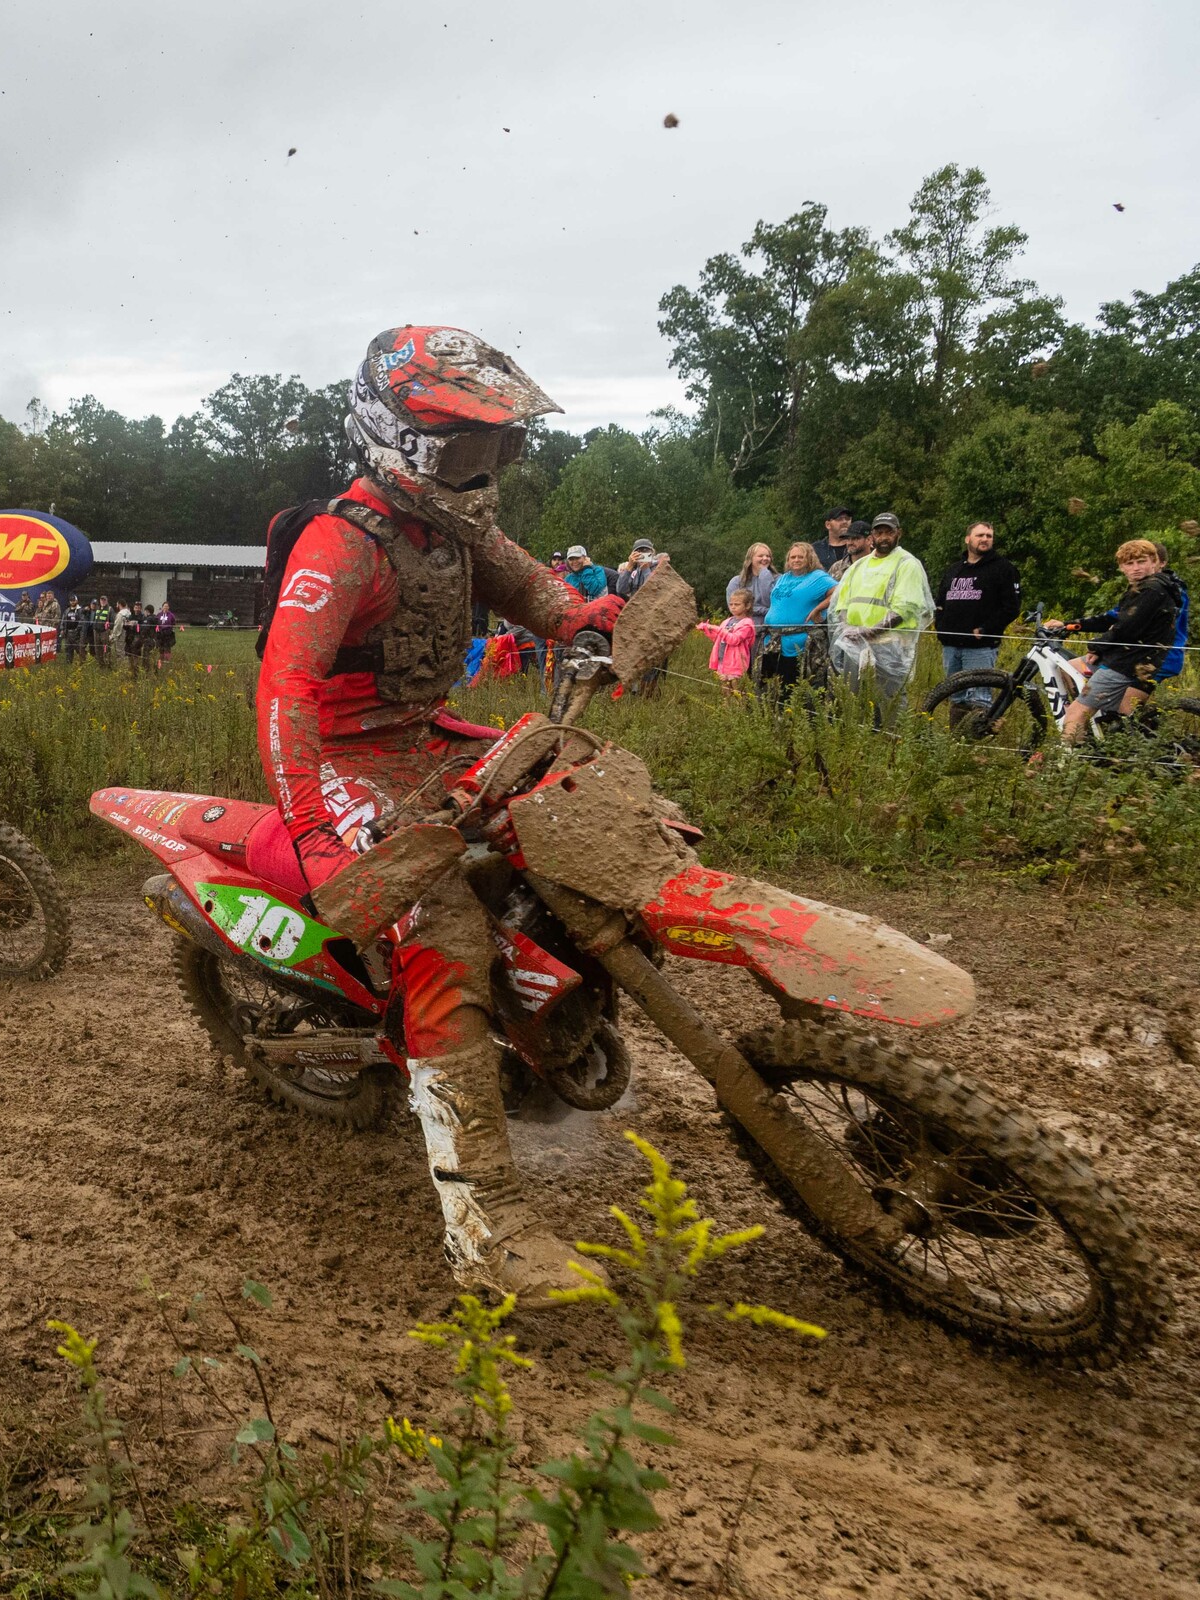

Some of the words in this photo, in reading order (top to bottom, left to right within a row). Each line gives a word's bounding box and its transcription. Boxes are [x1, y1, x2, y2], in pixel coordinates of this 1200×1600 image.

[950, 578, 974, 591] LIVE
[132, 825, 187, 852] DUNLOP
[228, 894, 306, 960] 10
